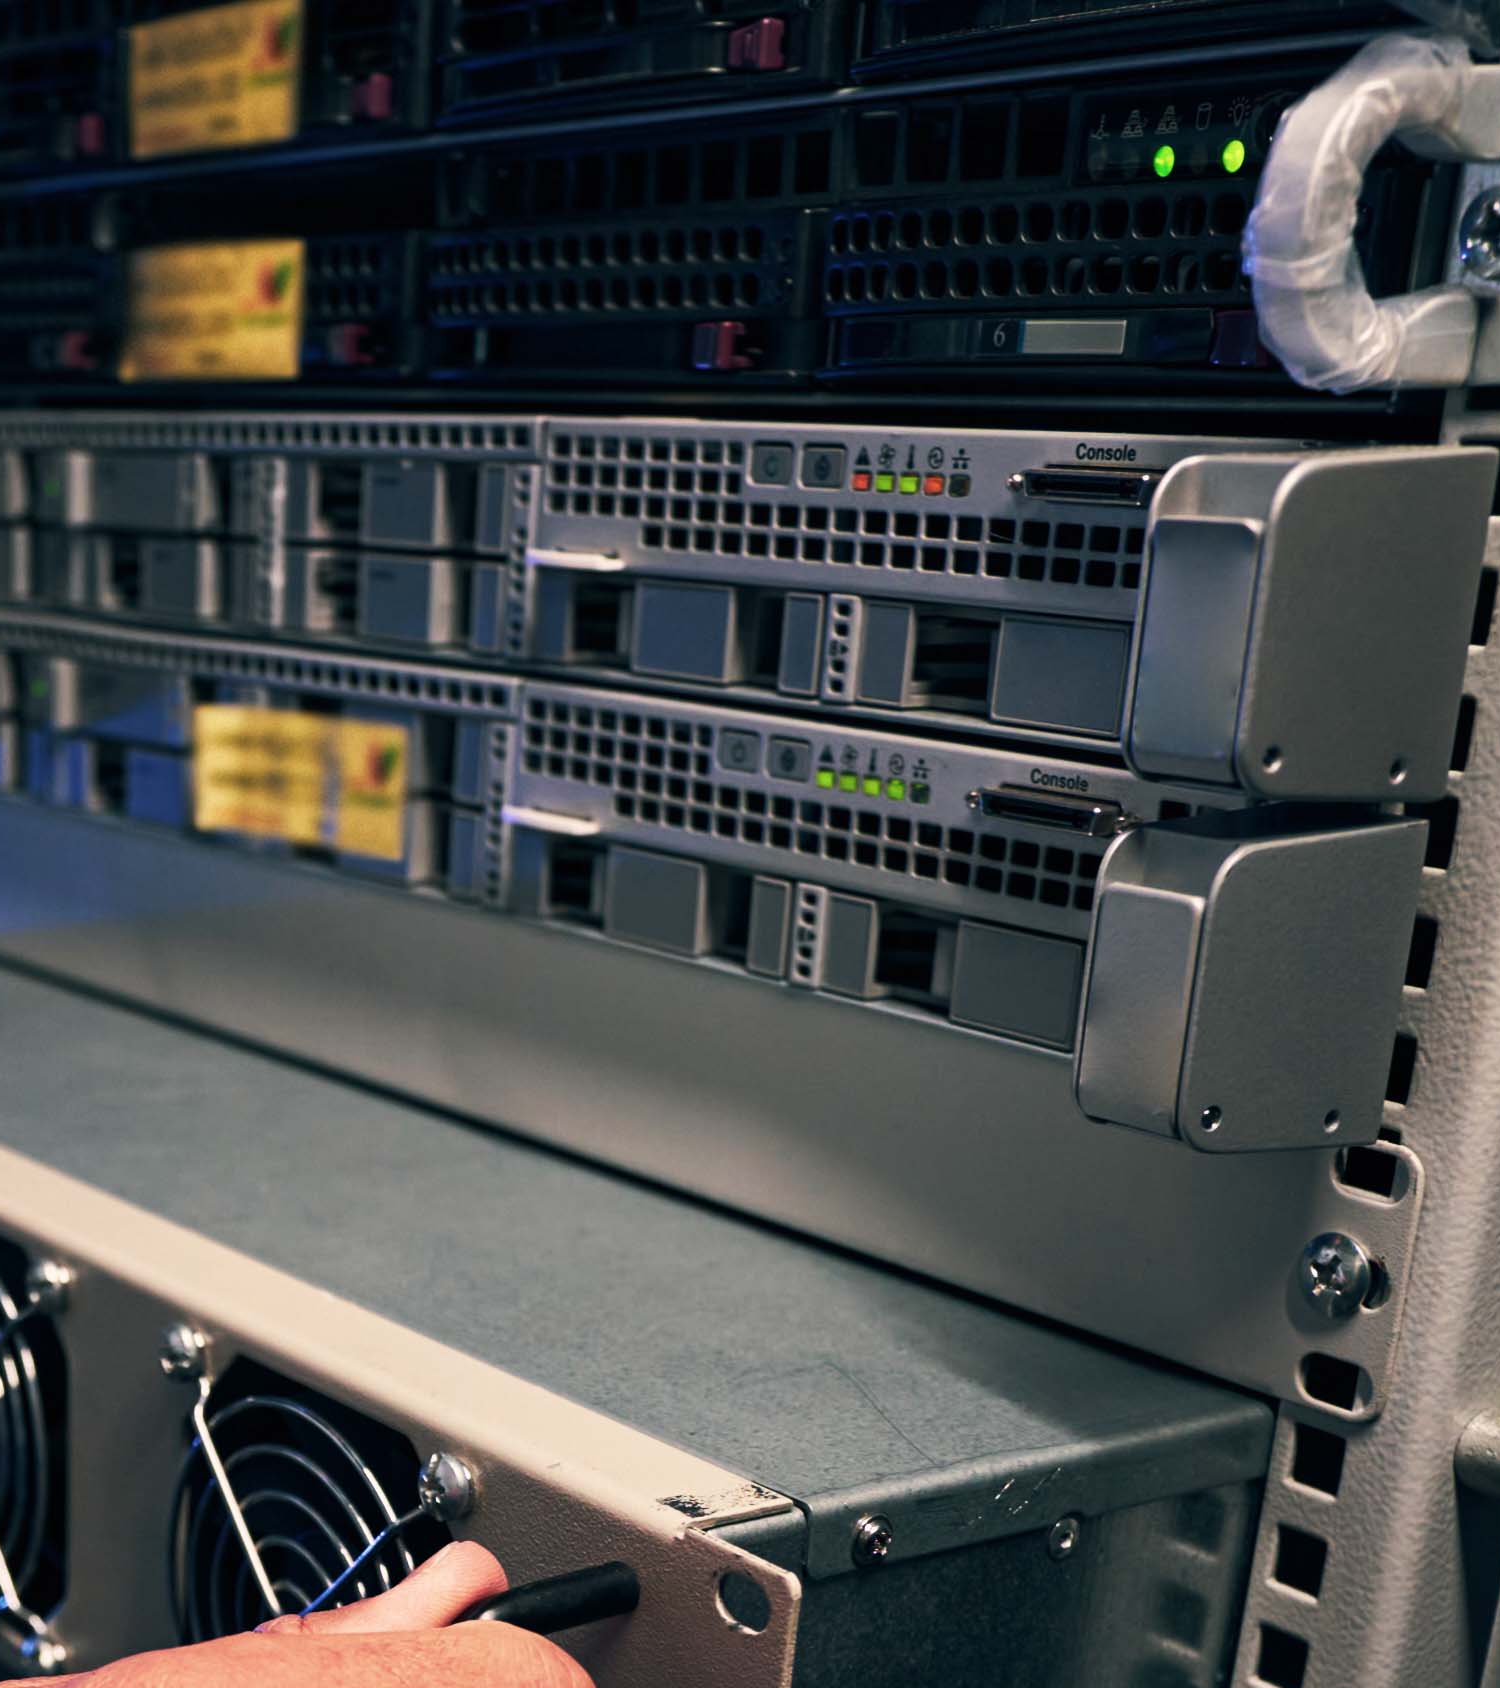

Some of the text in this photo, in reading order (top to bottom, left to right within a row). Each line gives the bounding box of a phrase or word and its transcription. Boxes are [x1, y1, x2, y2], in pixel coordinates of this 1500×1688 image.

[993, 322, 1006, 348] 6
[1075, 442, 1137, 461] Console
[1030, 767, 1089, 792] Console
